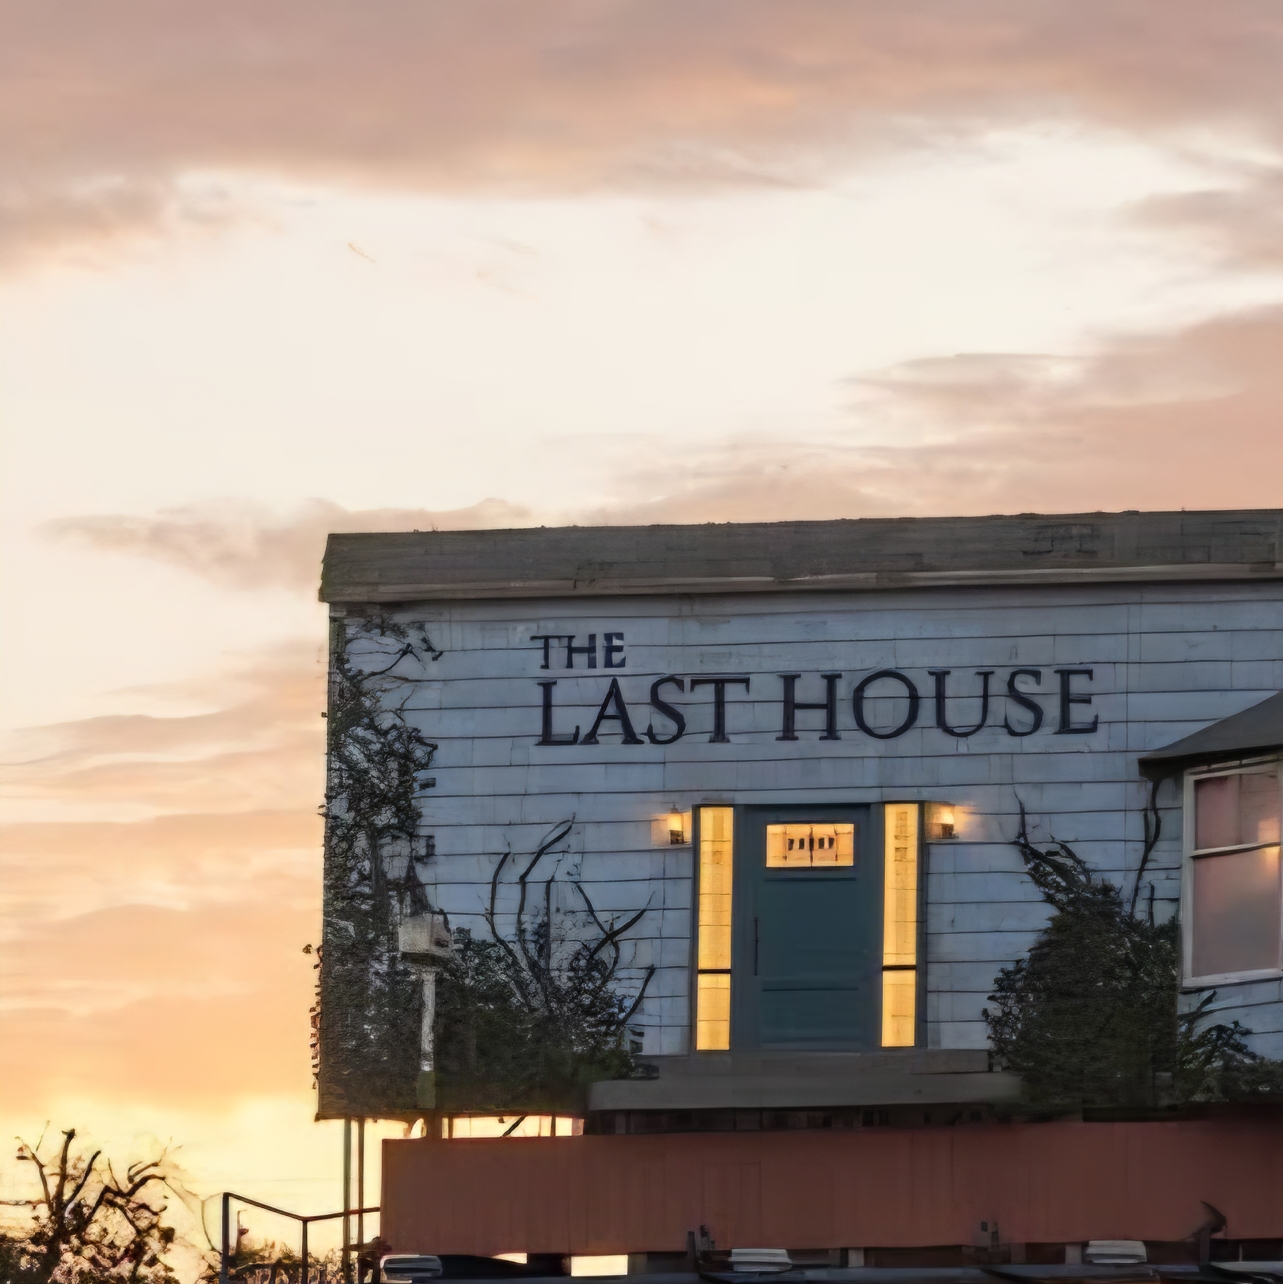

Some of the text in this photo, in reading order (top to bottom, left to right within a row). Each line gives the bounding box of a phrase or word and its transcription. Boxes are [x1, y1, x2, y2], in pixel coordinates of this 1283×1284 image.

[531, 631, 627, 670] THE
[534, 666, 1101, 746] LAST HOUSE
